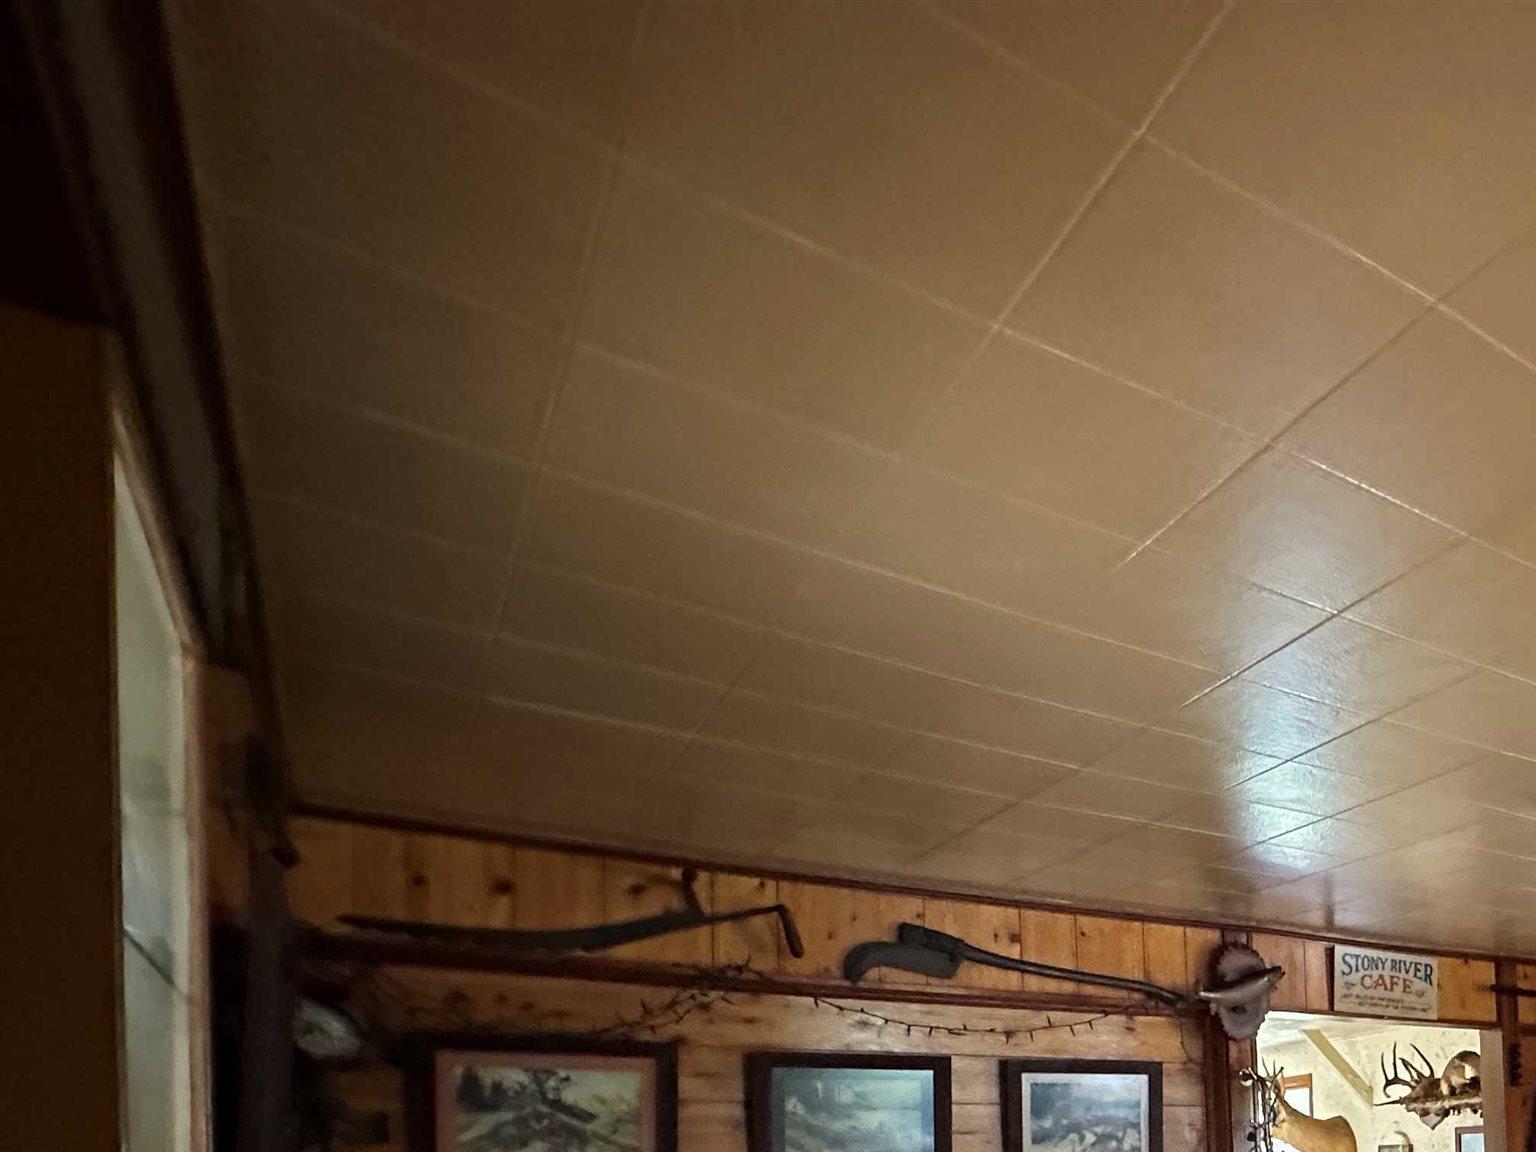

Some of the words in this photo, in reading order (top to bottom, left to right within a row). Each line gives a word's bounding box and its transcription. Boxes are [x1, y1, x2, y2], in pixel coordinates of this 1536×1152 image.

[1341, 952, 1389, 976] STONY
[1390, 958, 1433, 986] RIVER
[1360, 974, 1414, 994] CAFE
